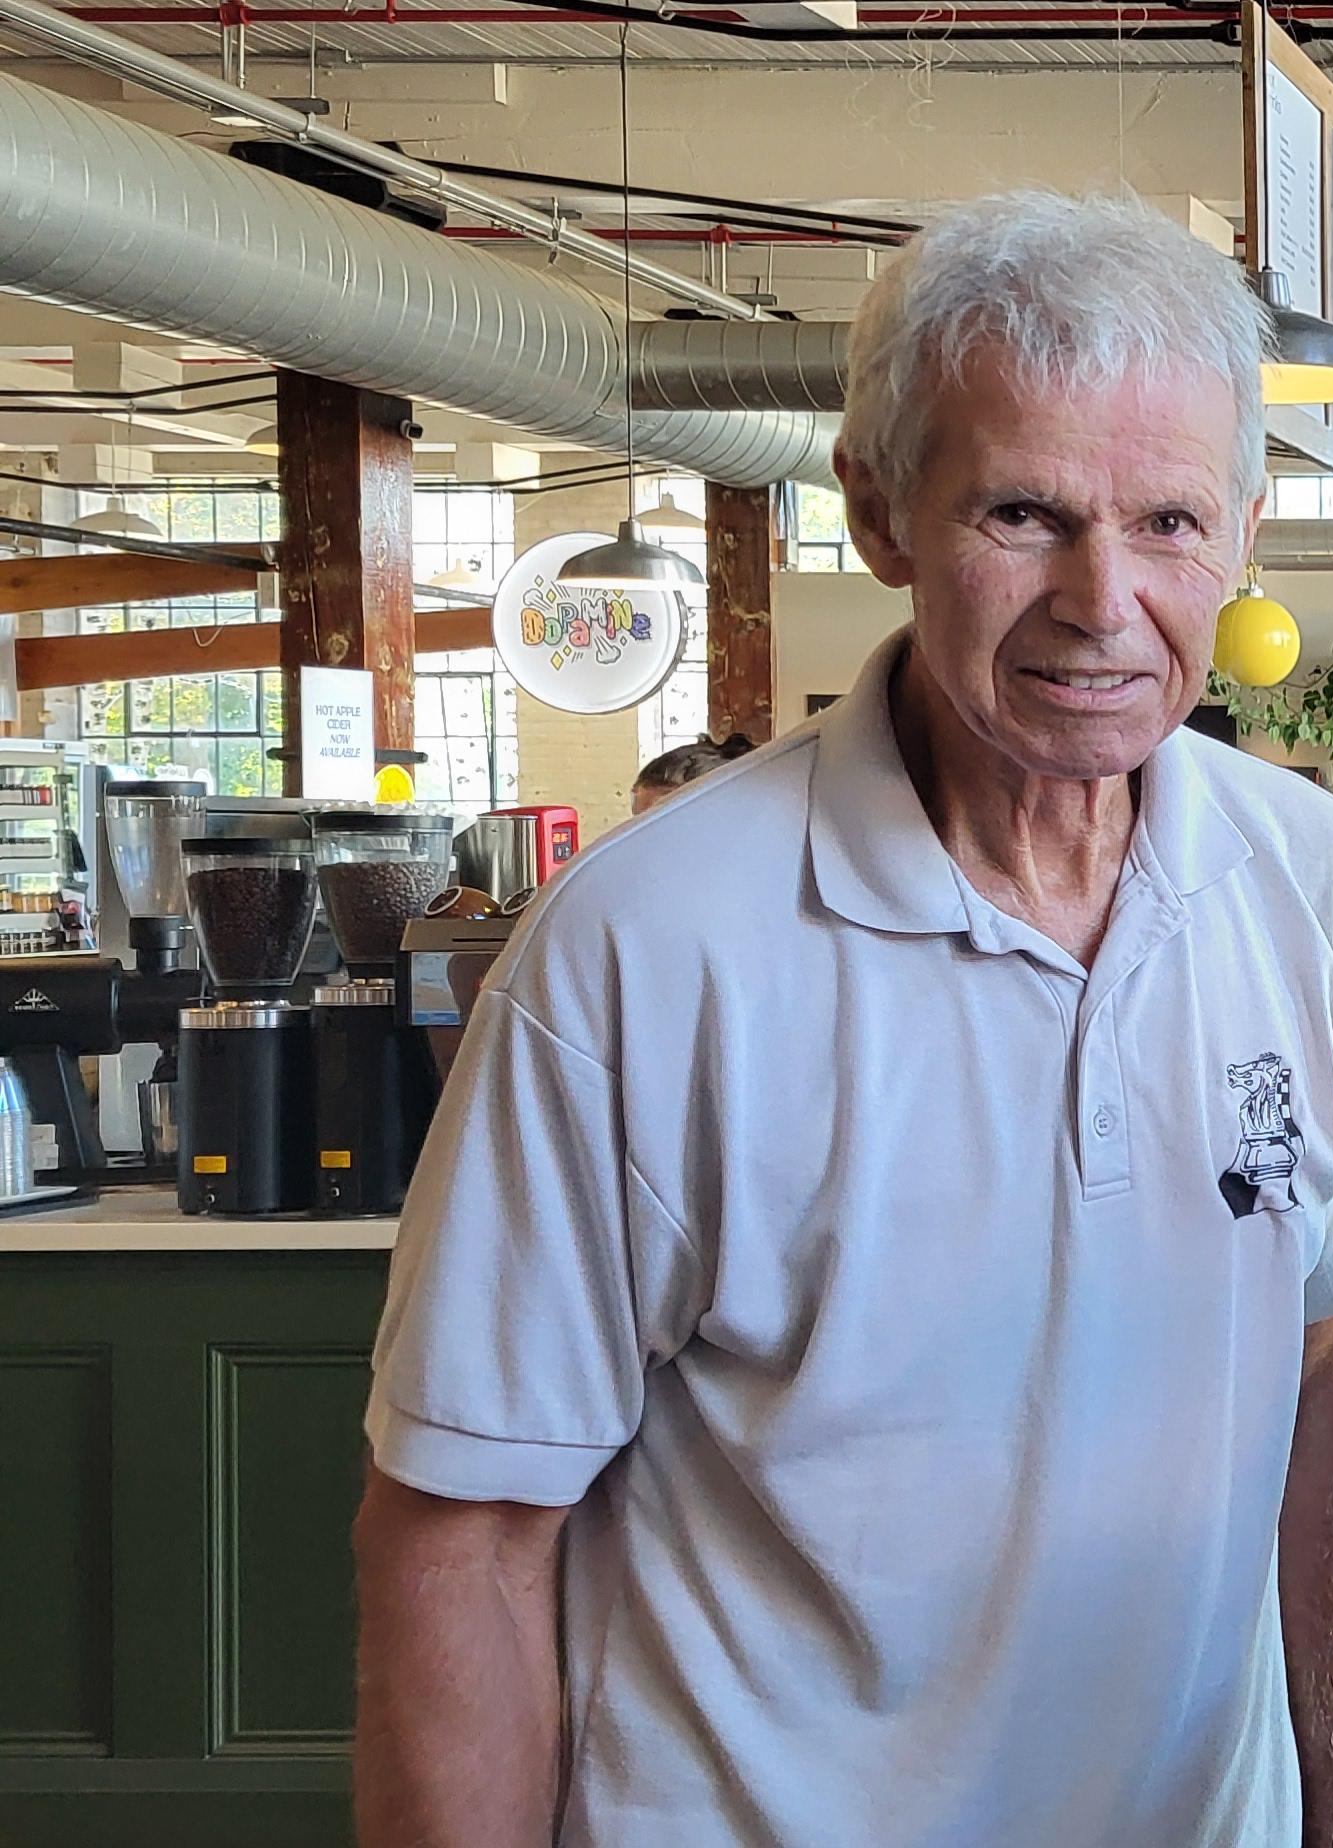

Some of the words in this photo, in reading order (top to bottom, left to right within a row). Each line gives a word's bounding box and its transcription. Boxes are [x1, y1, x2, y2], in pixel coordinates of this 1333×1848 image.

[315, 704, 334, 716] HOT
[335, 706, 361, 717] APPLE
[326, 718, 351, 730] CIDER
[330, 734, 351, 745] NOW
[320, 747, 361, 758] AVAILABLE
